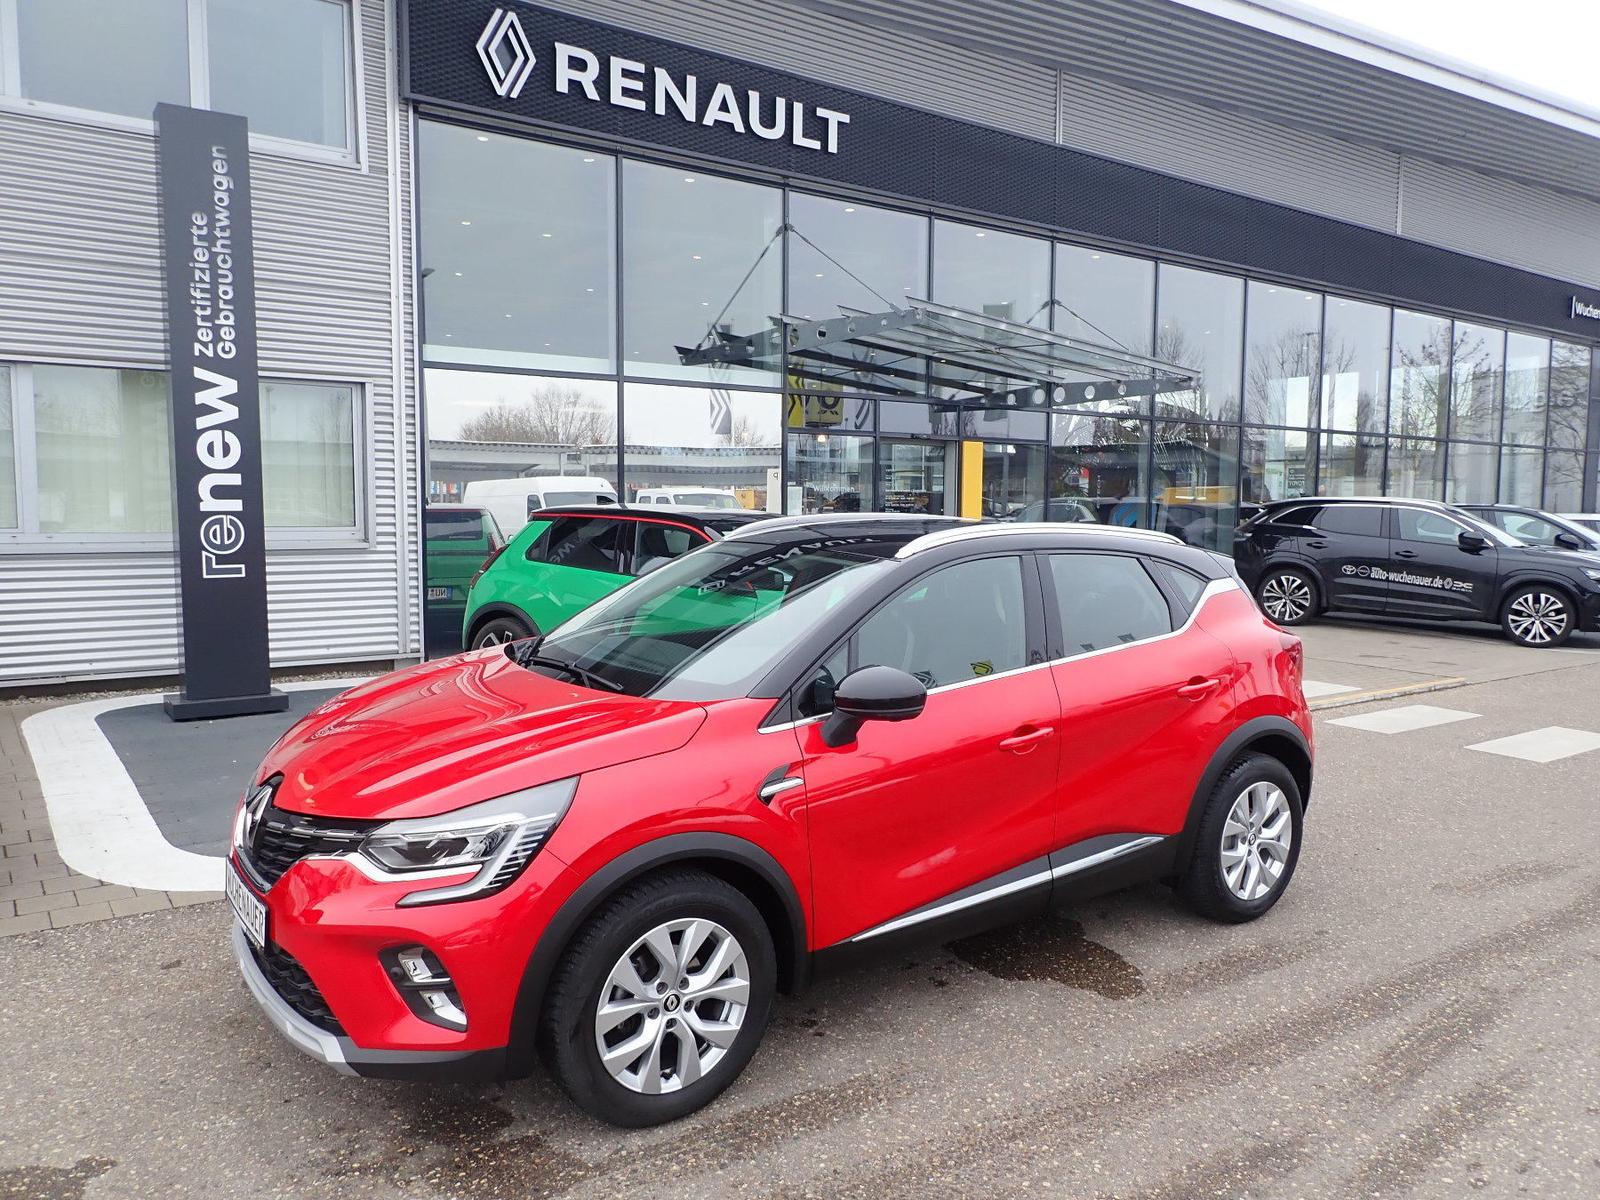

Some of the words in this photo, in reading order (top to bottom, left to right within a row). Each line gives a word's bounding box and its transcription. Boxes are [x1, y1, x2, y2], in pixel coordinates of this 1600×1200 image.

[554, 41, 850, 154] RENAULT
[189, 212, 214, 358] Zertifizierte
[211, 145, 237, 359] Gebrauchtwagen
[193, 366, 246, 578] renew
[1370, 568, 1443, 588] auto-wuchenauer.de
